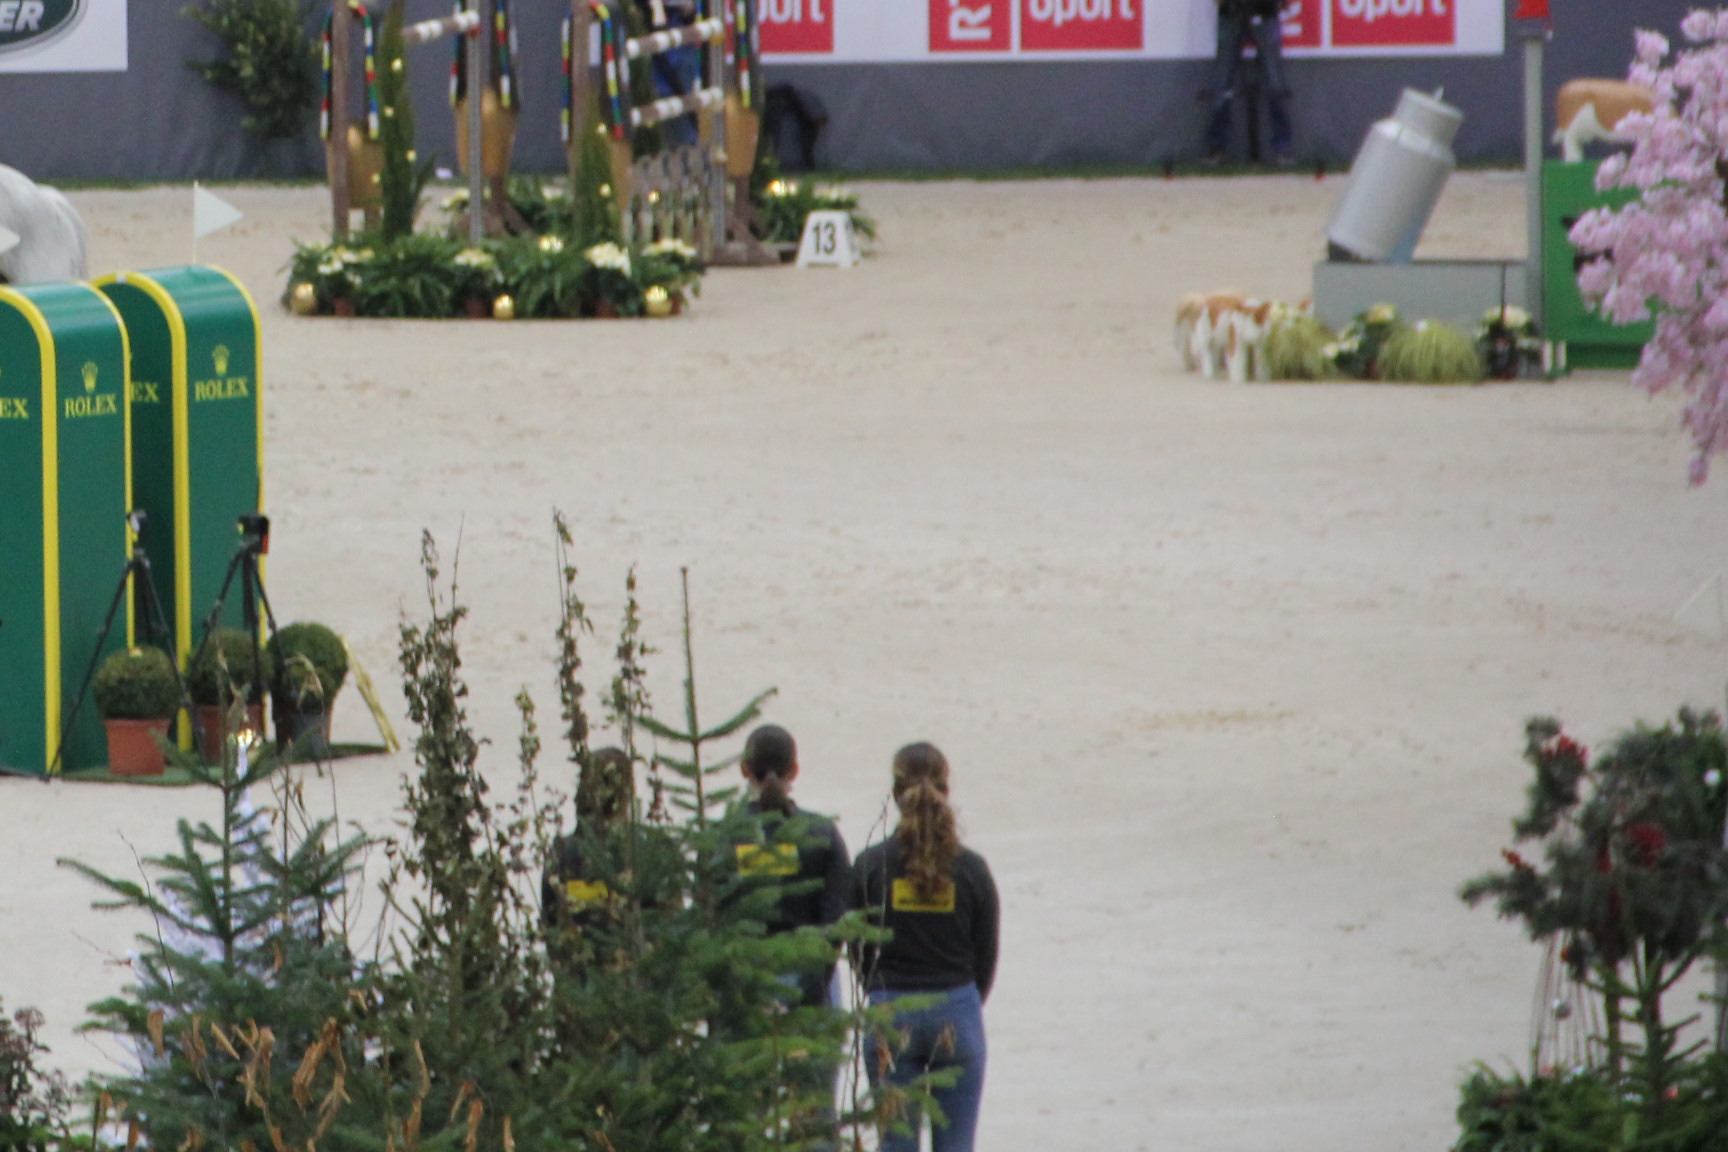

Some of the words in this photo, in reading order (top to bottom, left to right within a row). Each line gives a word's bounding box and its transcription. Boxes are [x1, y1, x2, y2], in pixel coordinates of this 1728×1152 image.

[813, 222, 837, 255] 13
[194, 376, 249, 402] ROLEX
[64, 393, 118, 419] ROLEX
